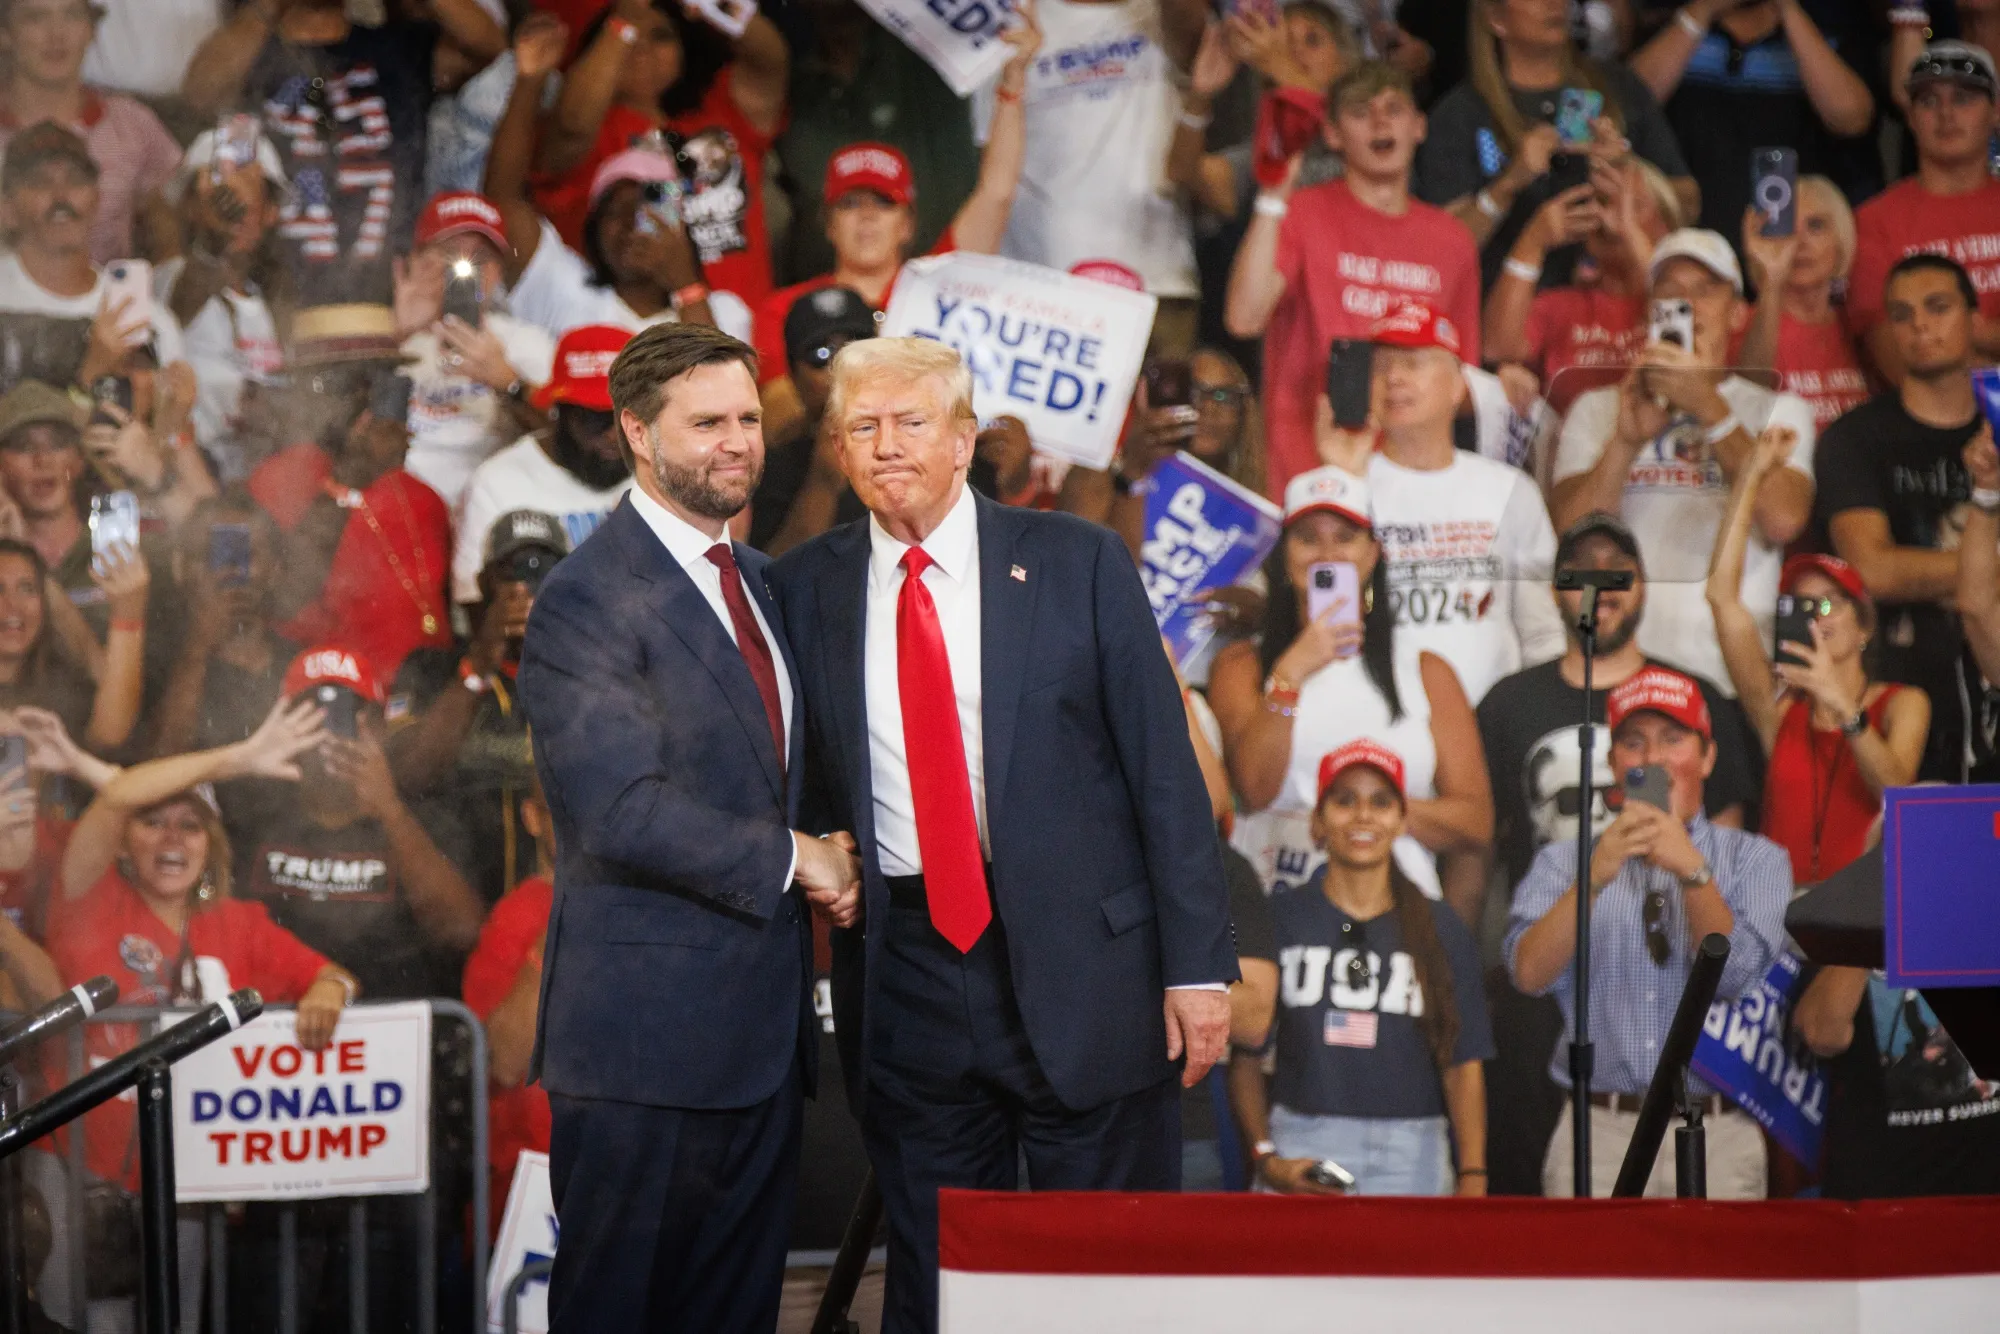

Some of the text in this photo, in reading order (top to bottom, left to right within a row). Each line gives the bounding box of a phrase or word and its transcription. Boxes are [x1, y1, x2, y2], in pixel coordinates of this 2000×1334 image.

[935, 293, 1102, 370] YOU'RE
[303, 650, 361, 682] USA
[266, 850, 387, 885] TRUMP
[1279, 944, 1425, 1018] USA
[232, 1040, 367, 1080] VOTE
[190, 1080, 404, 1124] DONALD
[1886, 1107, 1944, 1128] NEVER
[207, 1124, 388, 1166] TRUMP
